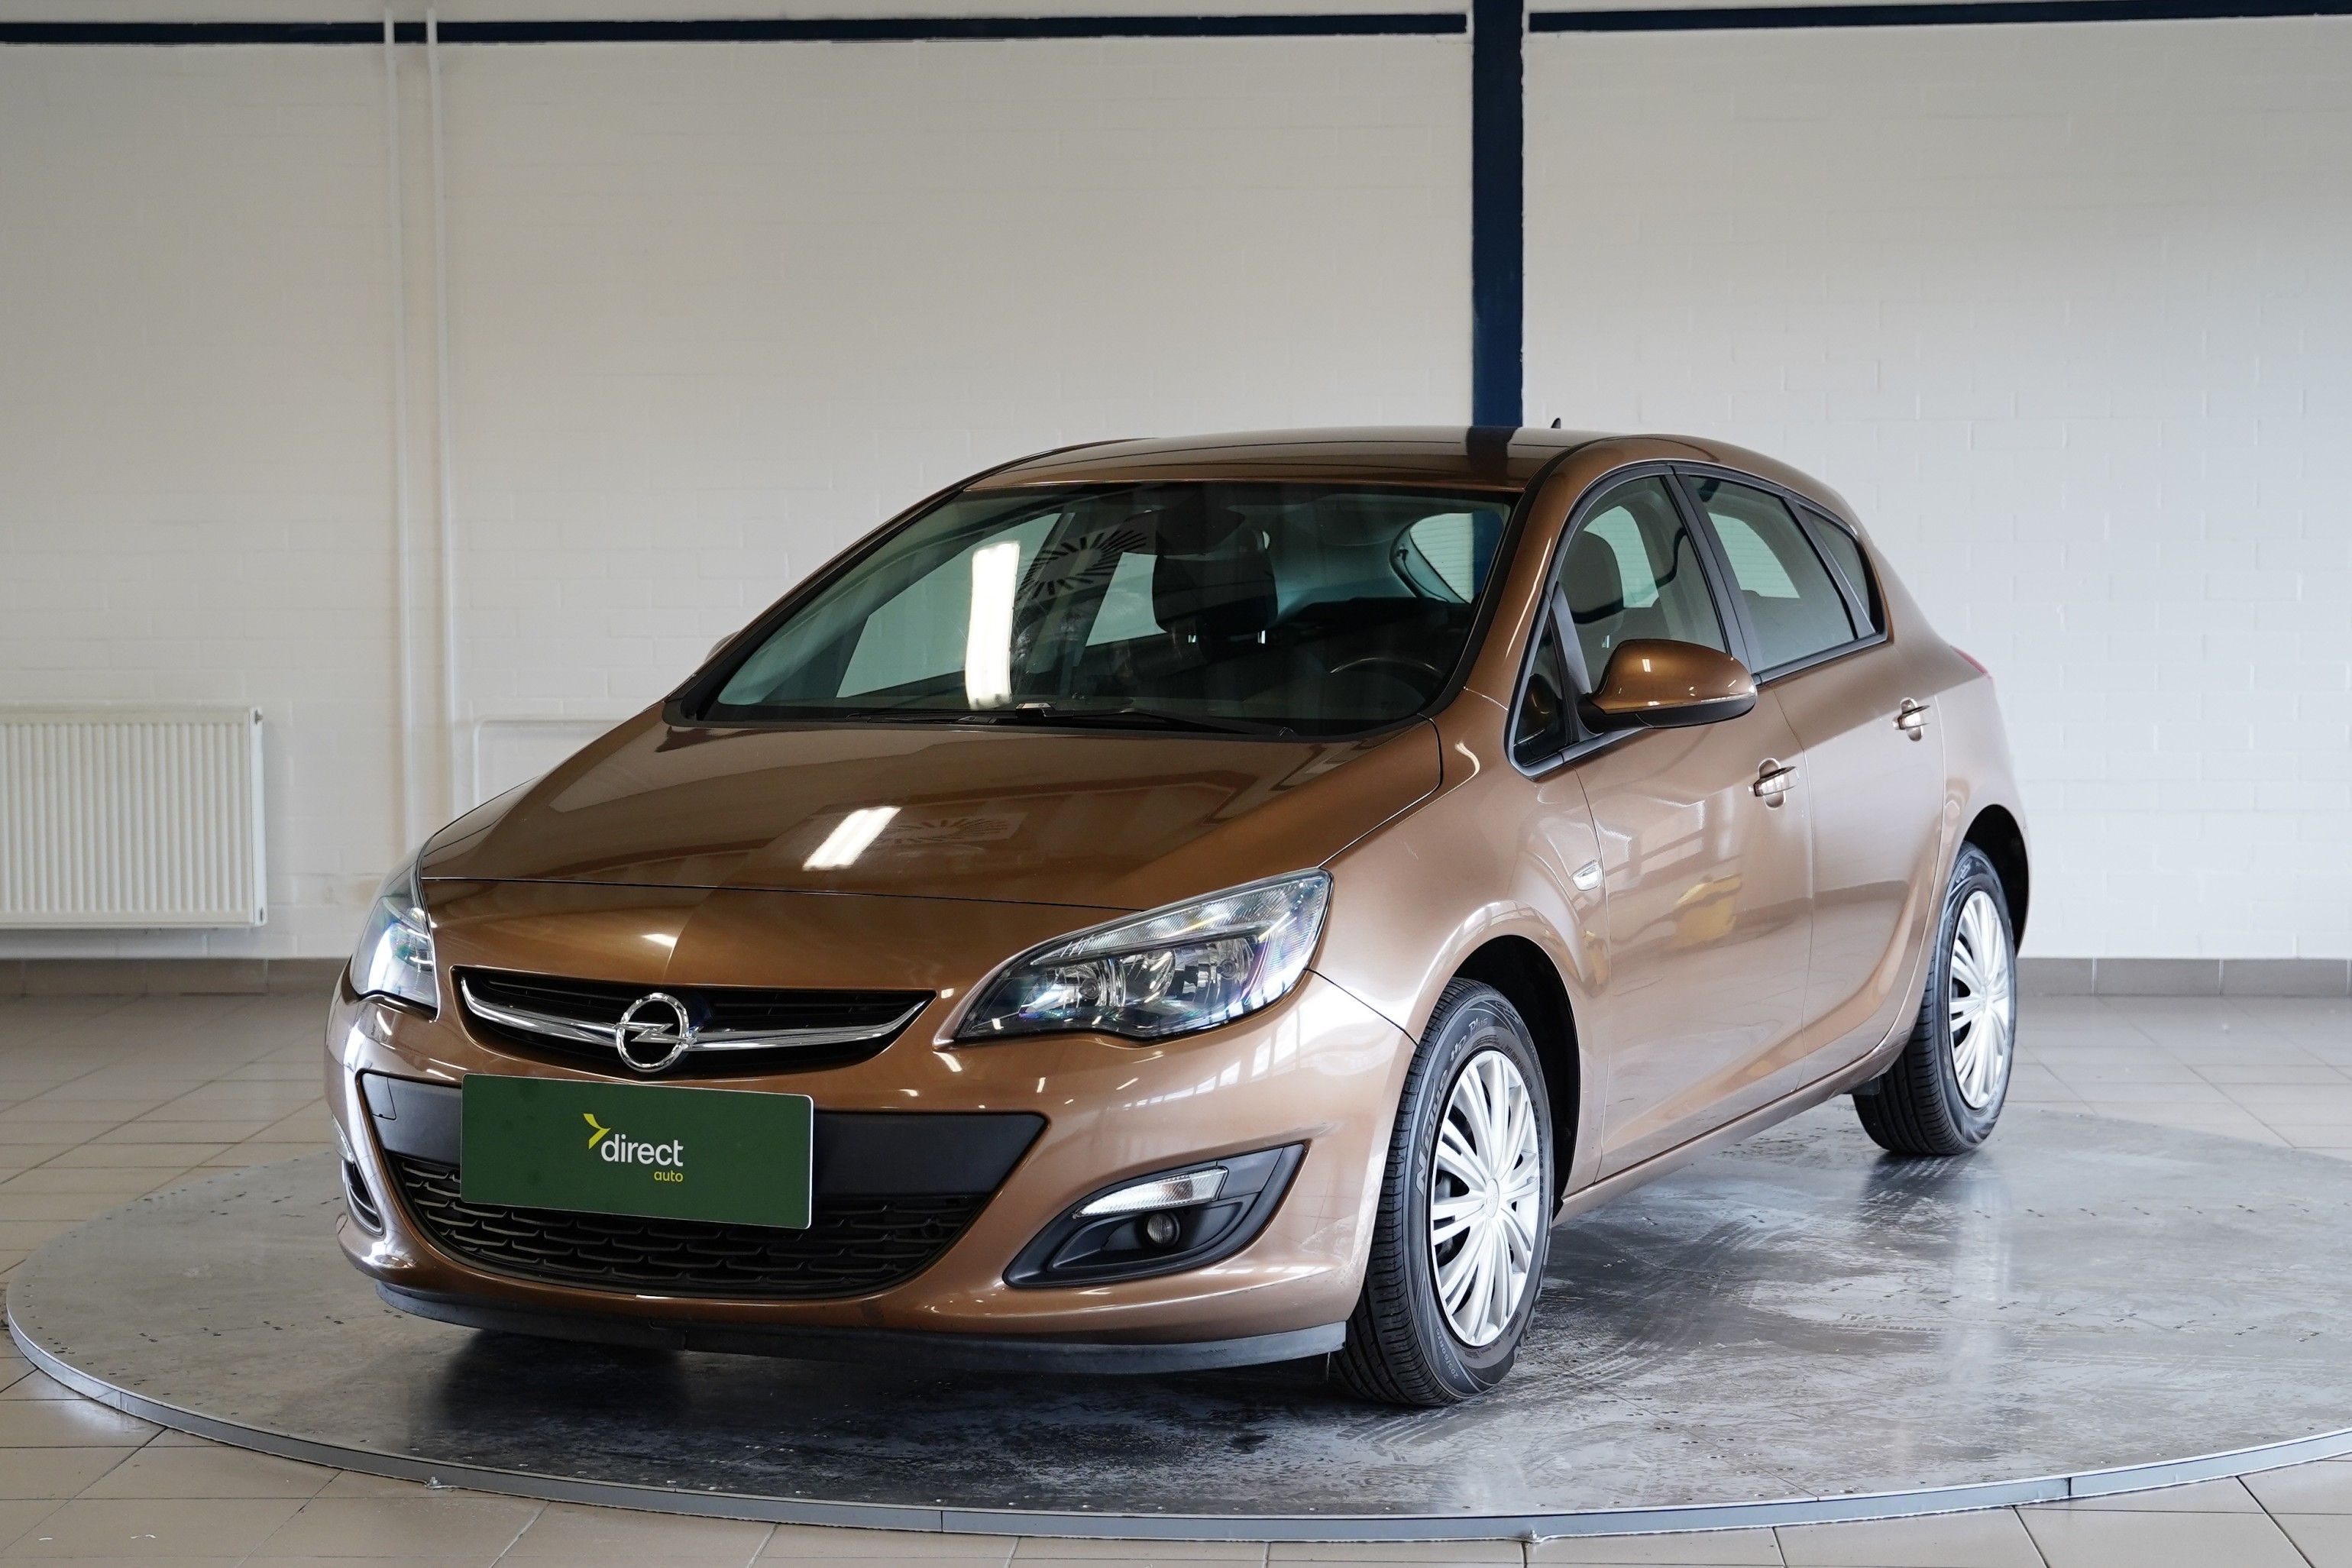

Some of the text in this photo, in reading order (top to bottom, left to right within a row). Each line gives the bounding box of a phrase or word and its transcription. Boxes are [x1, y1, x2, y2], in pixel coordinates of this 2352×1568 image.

[1468, 1017, 1488, 1035] Plus
[600, 1133, 684, 1166] direct
[654, 1169, 684, 1183] auto
